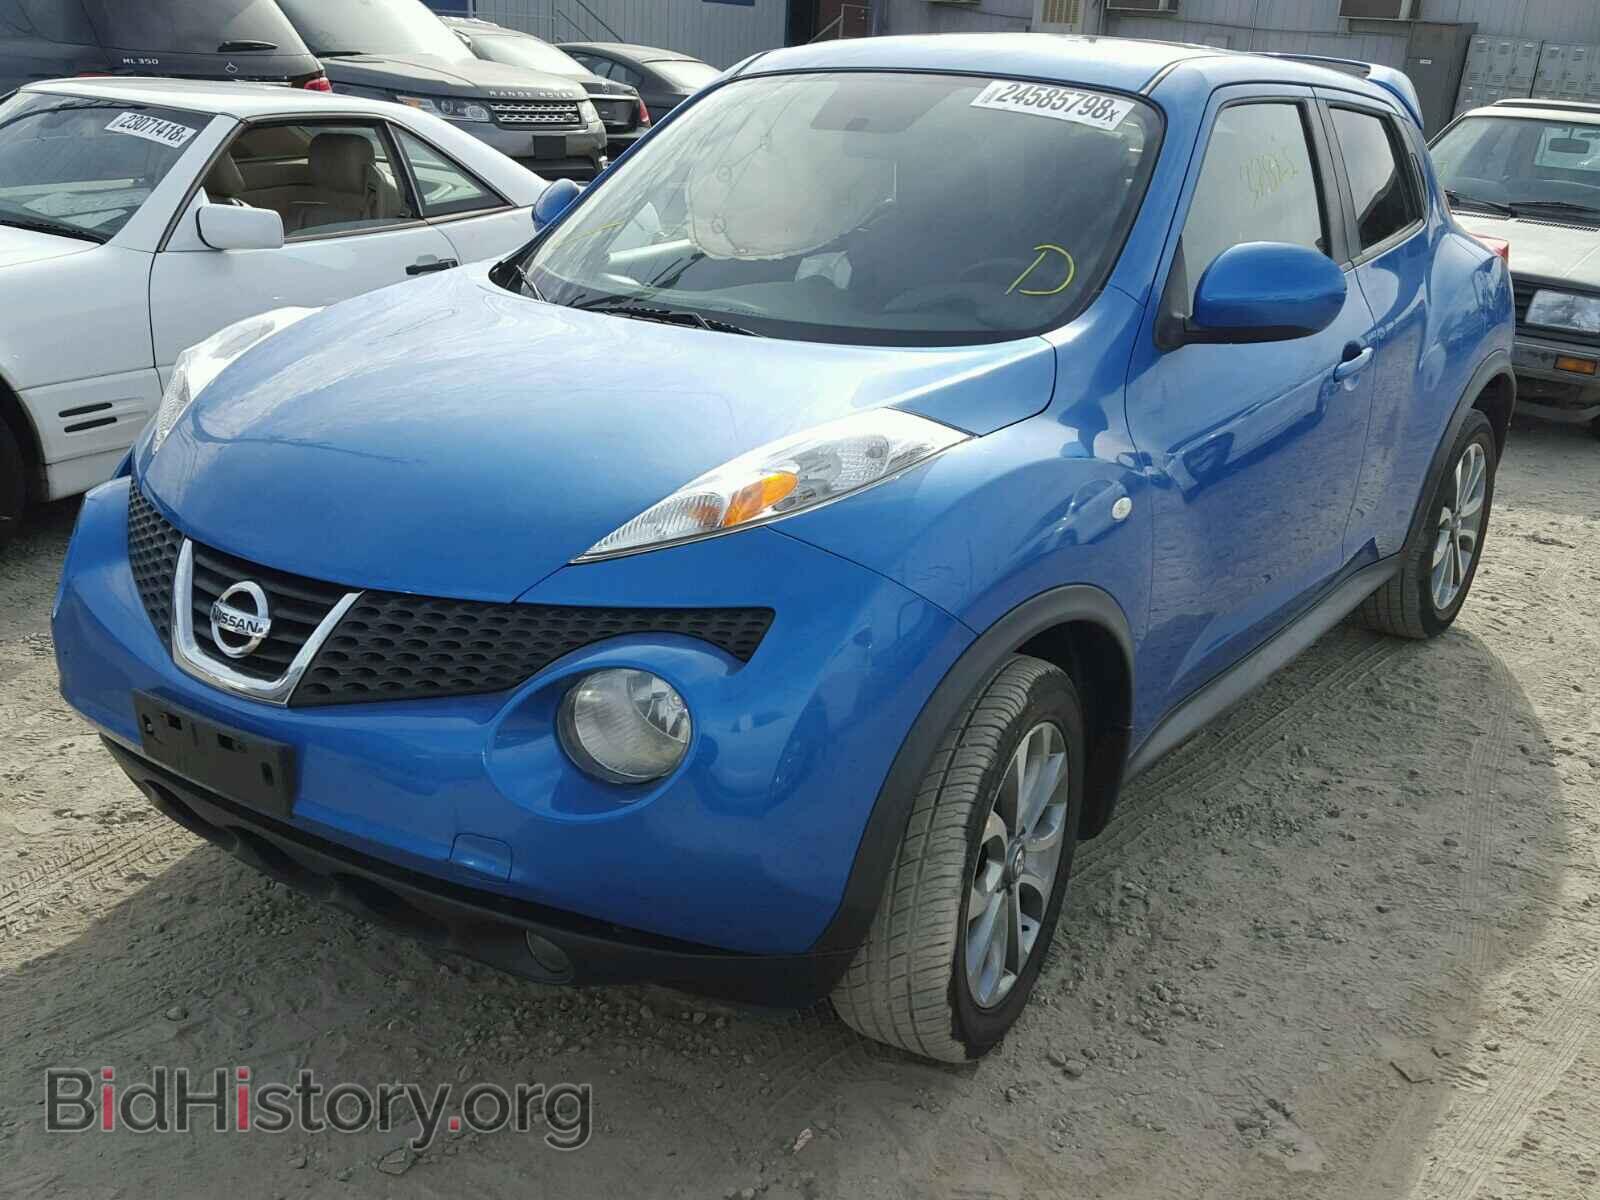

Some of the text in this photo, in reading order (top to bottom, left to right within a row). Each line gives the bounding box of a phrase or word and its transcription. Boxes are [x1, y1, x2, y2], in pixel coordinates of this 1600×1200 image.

[122, 57, 159, 65] ML 350
[1004, 243, 1075, 296] D
[211, 605, 260, 633] NISSAN
